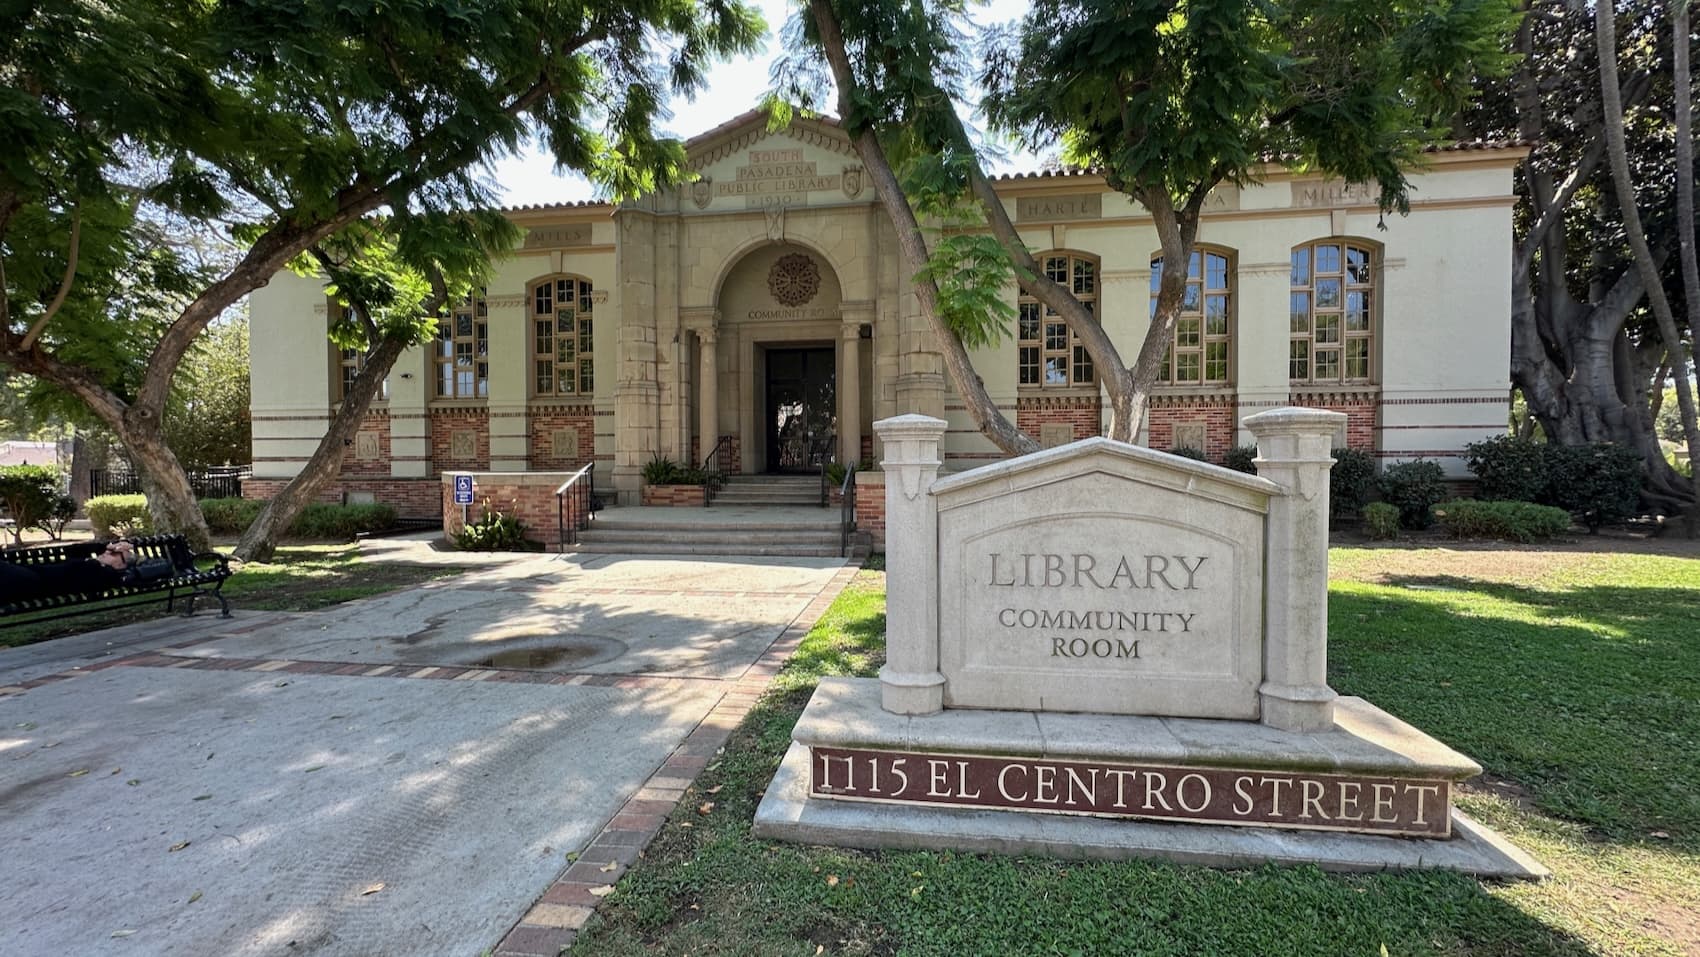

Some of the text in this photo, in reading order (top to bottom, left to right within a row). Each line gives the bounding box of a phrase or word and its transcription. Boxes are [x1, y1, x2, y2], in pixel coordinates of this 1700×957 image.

[752, 151, 800, 163] SOUTH
[740, 165, 814, 178] PASADENA
[719, 178, 833, 194] PUBLIC LIBRARY
[1304, 184, 1370, 201] MILLER
[760, 195, 792, 206] 1930
[534, 231, 581, 241] MILLS
[748, 307, 842, 320] COMMUNITY ROM
[989, 553, 1208, 590] LIBRARY
[999, 608, 1197, 632] COMMUNITY
[1051, 637, 1141, 658] ROOM
[819, 754, 1438, 824] 1115 EL CENTRO STREET
